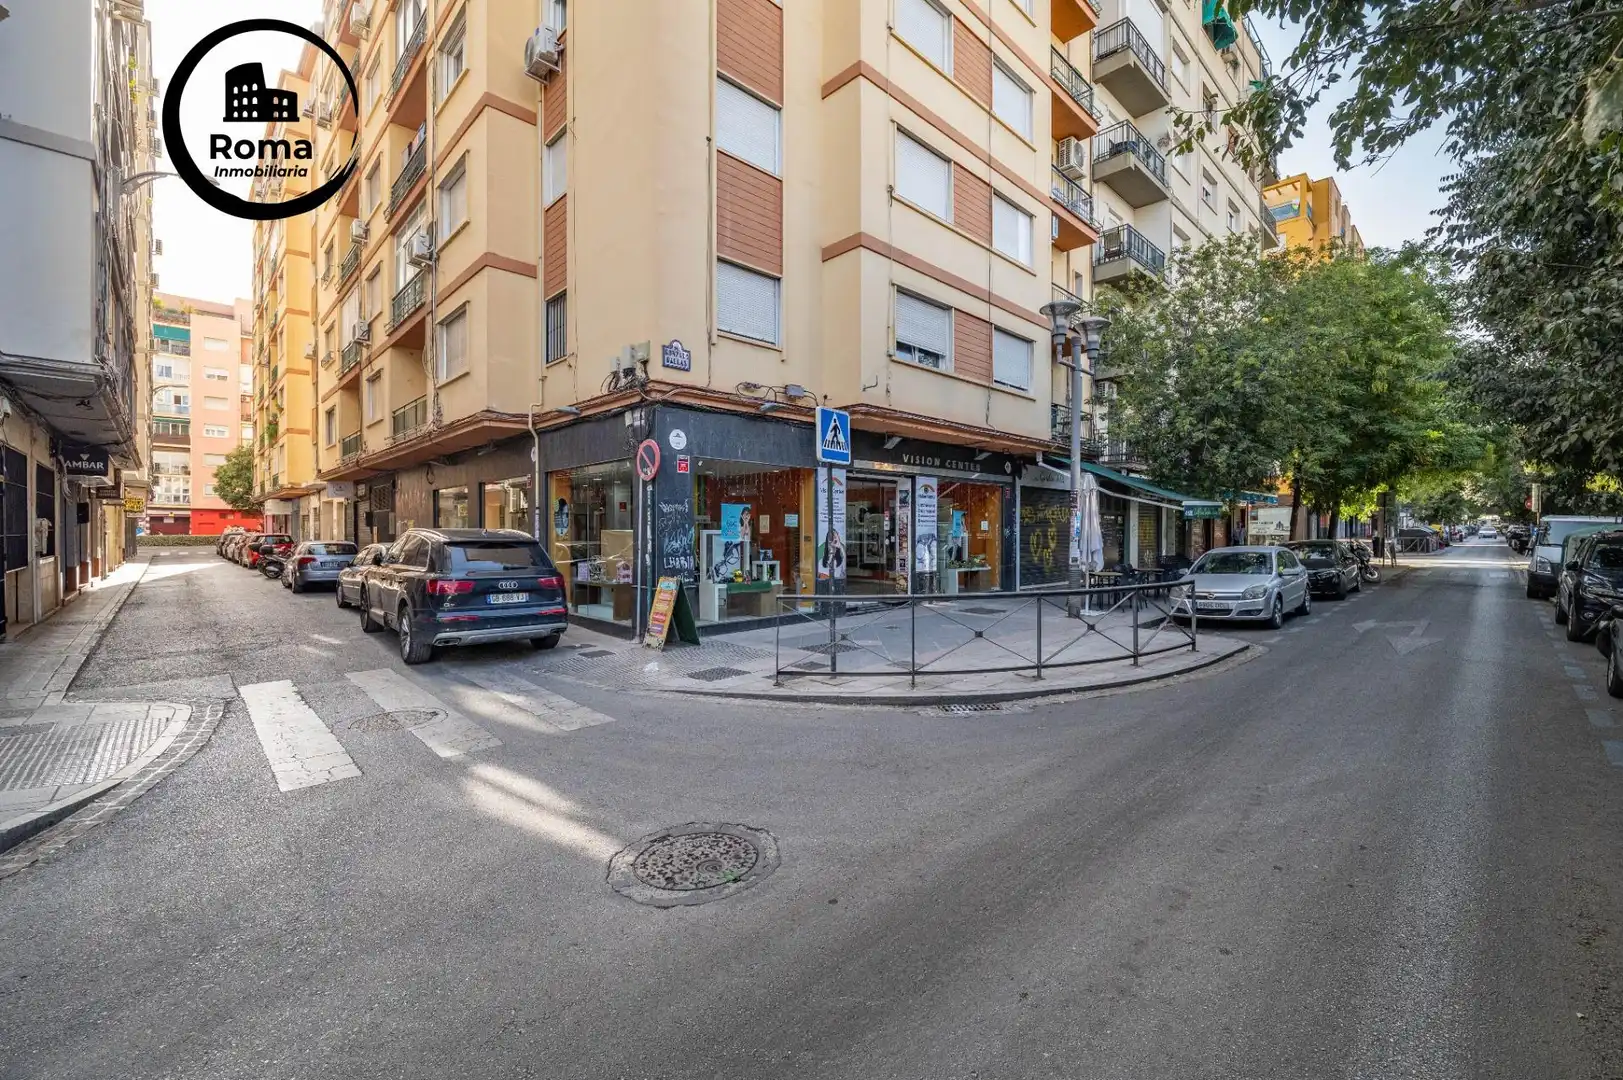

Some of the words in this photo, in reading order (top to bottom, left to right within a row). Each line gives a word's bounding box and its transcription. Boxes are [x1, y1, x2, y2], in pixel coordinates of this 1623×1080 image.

[65, 460, 105, 470] AMBAR
[902, 453, 940, 466] VISION
[945, 459, 981, 472] CENTER
